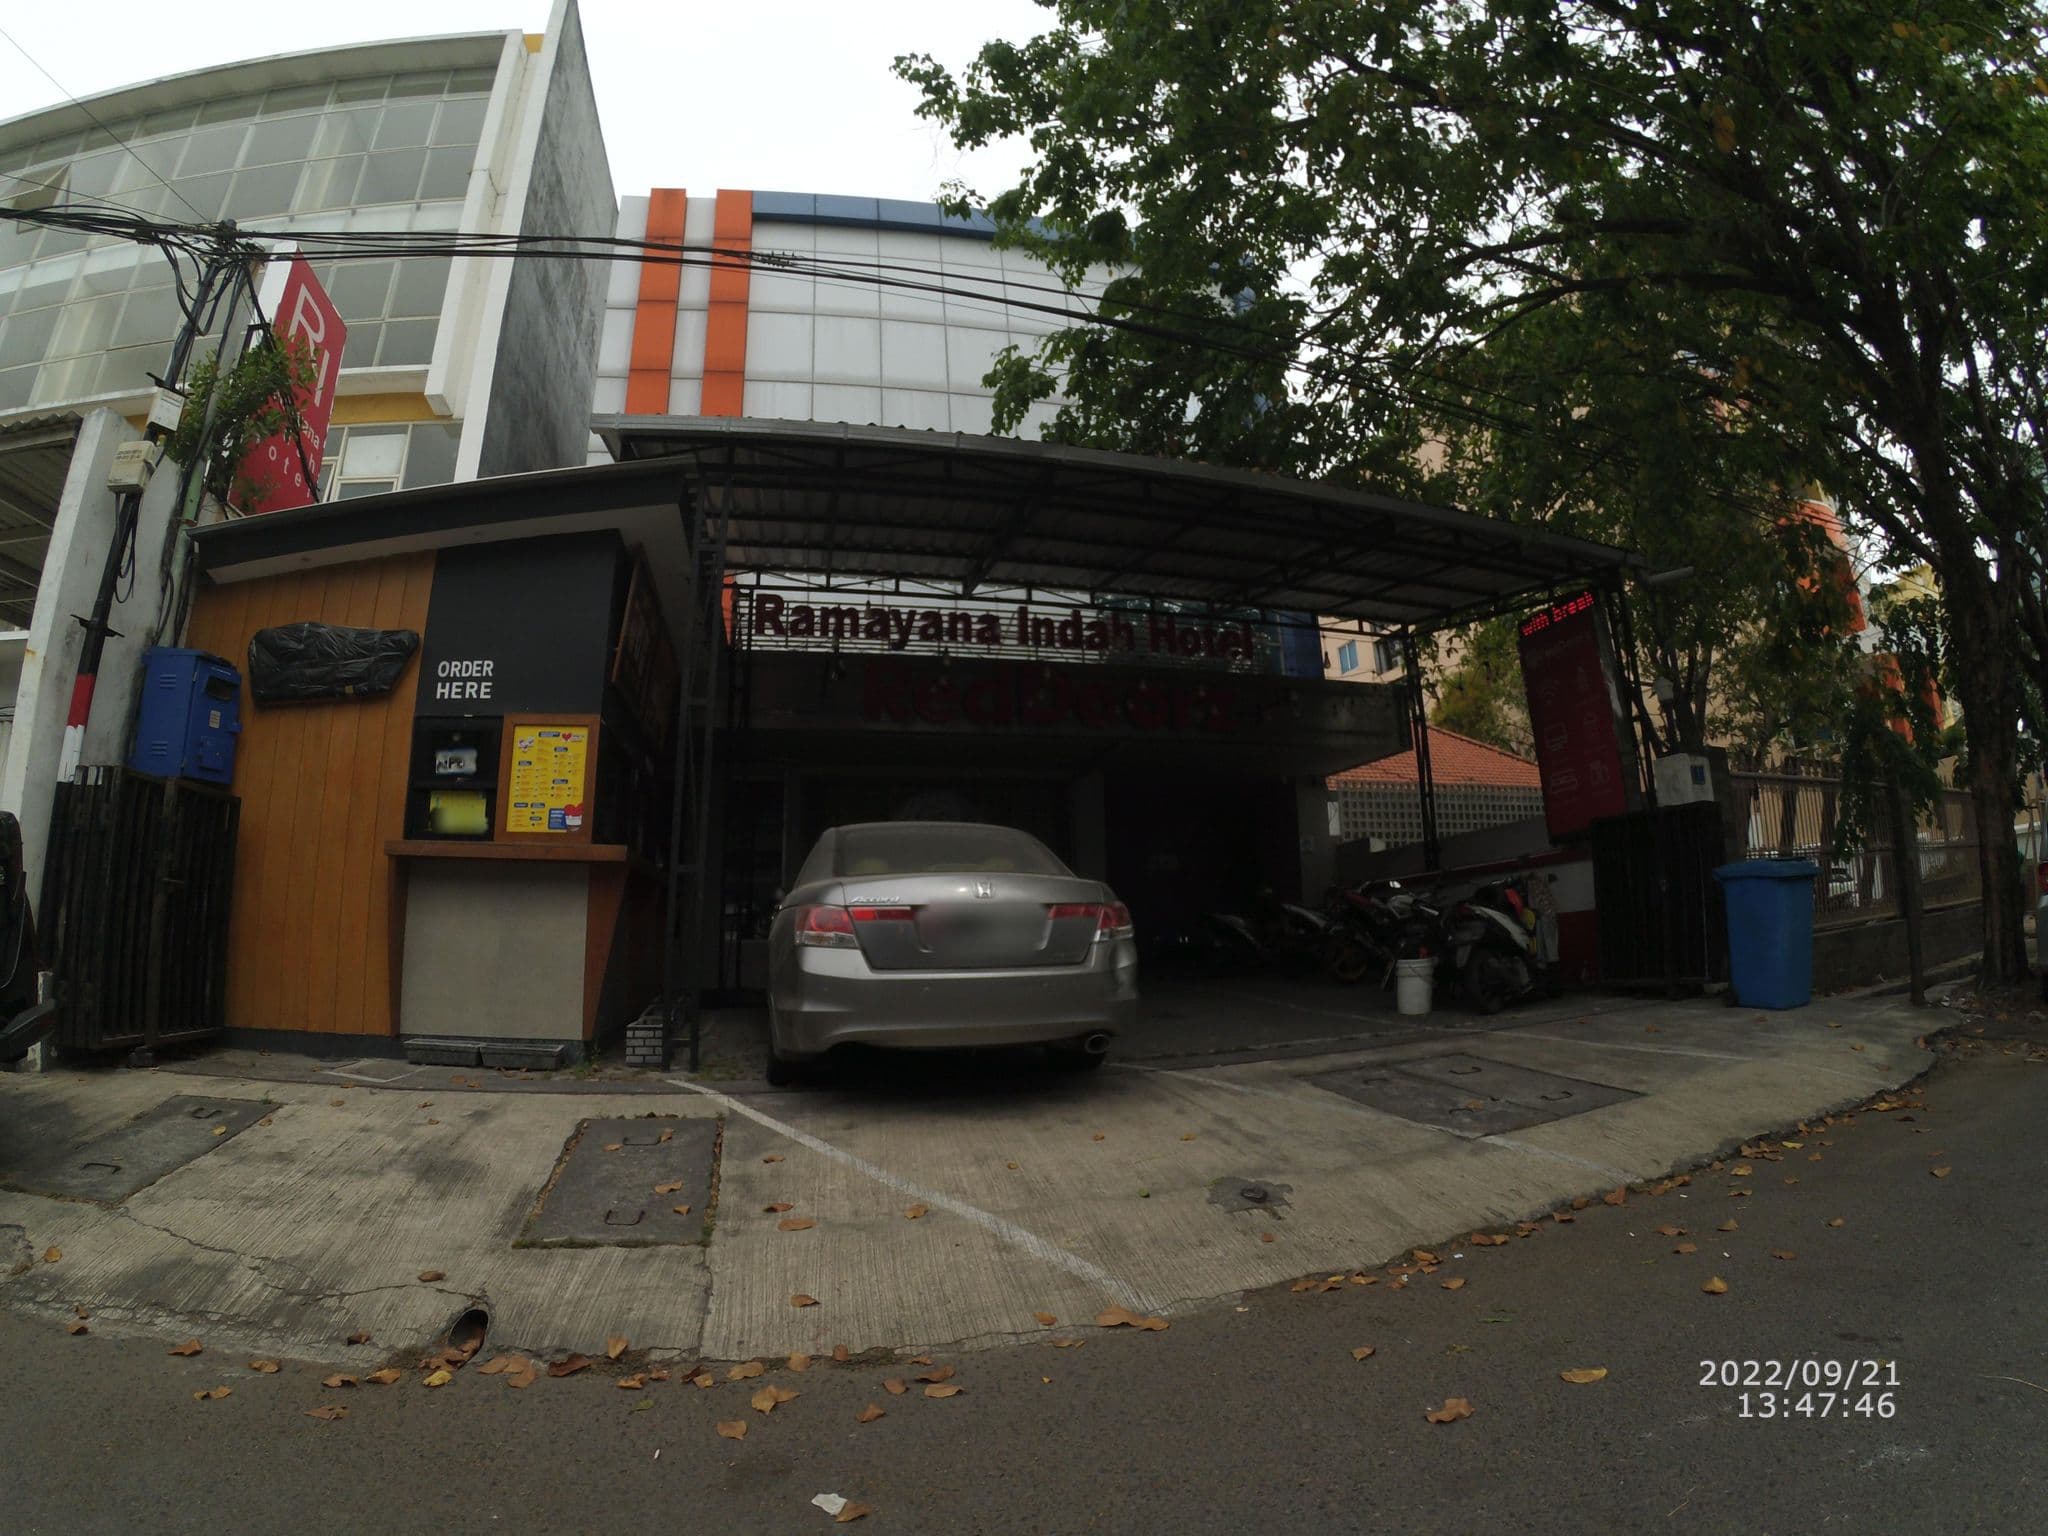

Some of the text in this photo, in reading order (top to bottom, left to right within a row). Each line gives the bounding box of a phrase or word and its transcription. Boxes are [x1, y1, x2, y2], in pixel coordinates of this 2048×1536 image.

[754, 593, 1255, 661] Ramayana Indah Hotel
[1522, 591, 1594, 636] with break
[436, 682, 493, 699] HERE
[437, 660, 494, 677] ORDER
[862, 656, 1242, 733] RedDoorz
